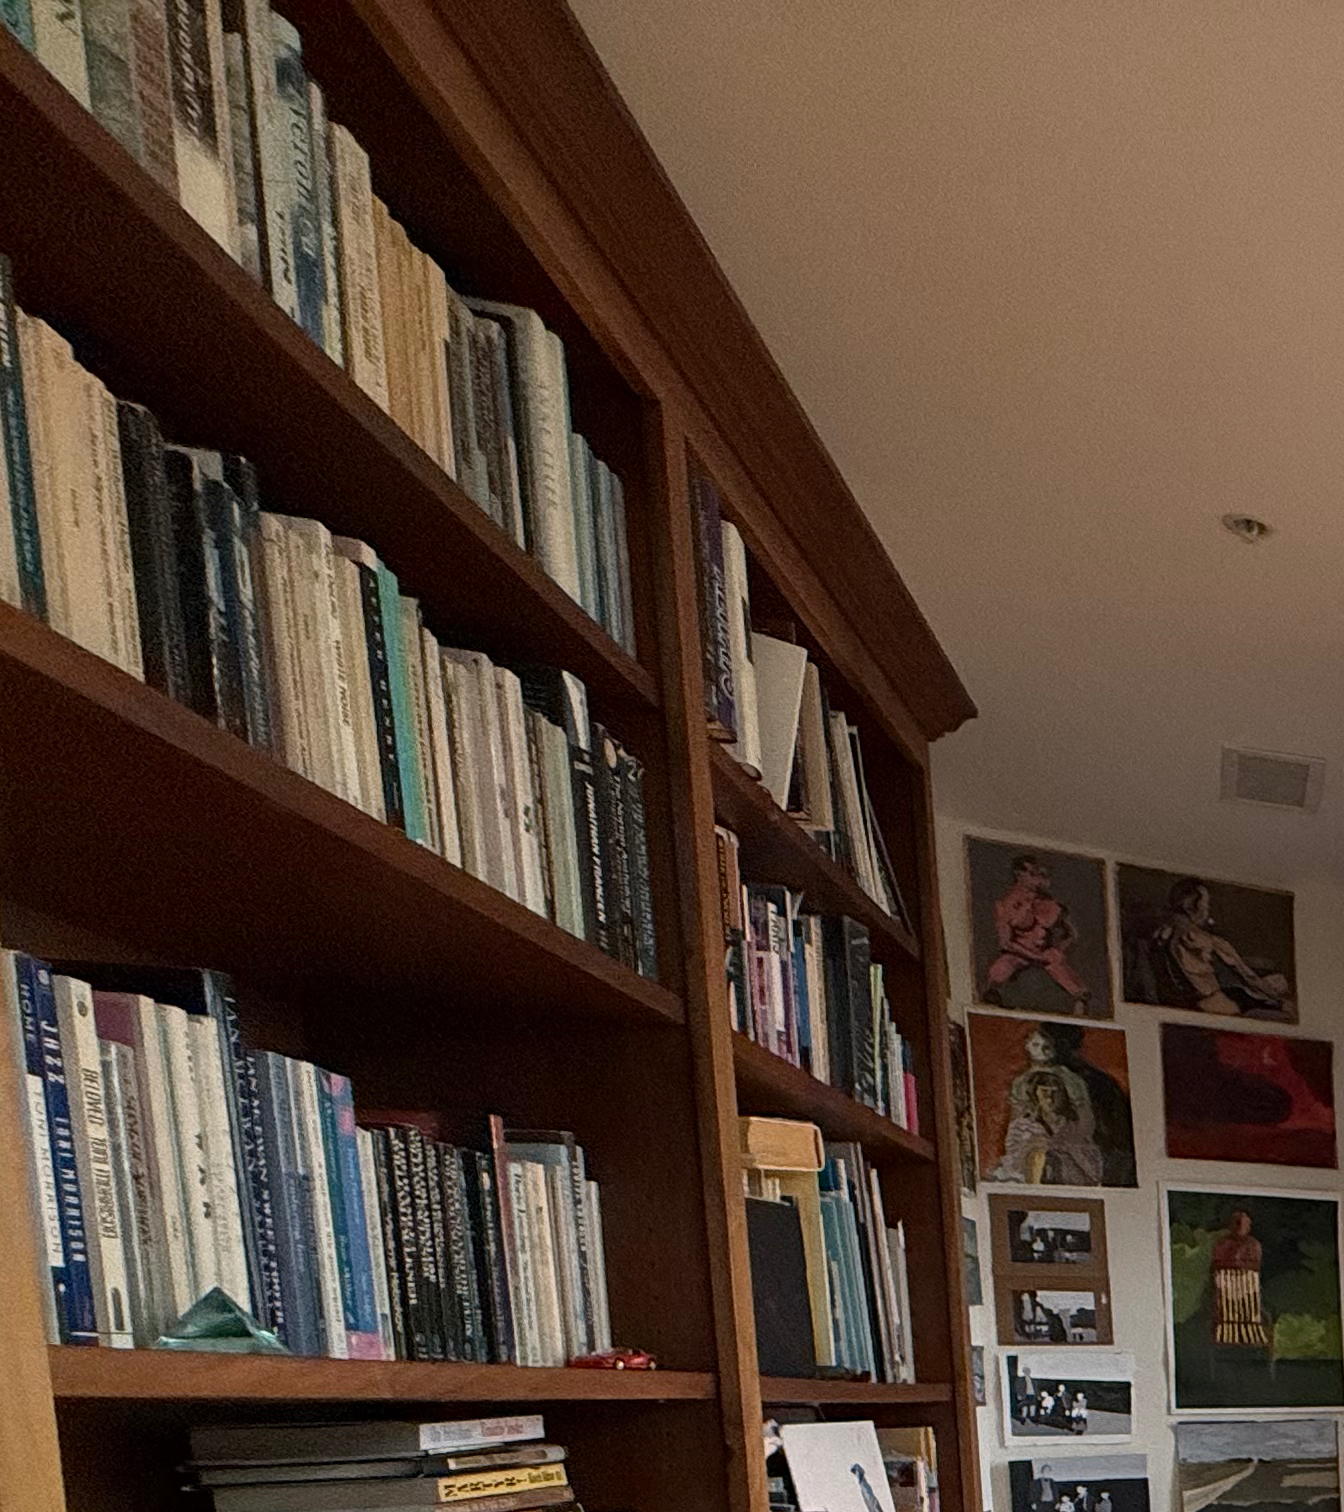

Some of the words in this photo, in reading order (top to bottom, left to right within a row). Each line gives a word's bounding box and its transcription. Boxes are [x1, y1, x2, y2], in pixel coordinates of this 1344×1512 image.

[584, 781, 600, 855] JONATHAN
[592, 857, 606, 925] FRANZEN
[20, 984, 36, 1042] HOME
[41, 1021, 65, 1086] JAZZ
[32, 1091, 47, 1138] TONI
[82, 1068, 105, 1125] BELOVED
[55, 1117, 72, 1159] TONI
[89, 1136, 110, 1165] TONI
[246, 1056, 258, 1091] IAN
[261, 1189, 277, 1253] SWEET
[39, 1148, 62, 1255] MORRISON
[61, 1168, 86, 1264] MORRISON
[94, 1168, 118, 1239] MORRISON
